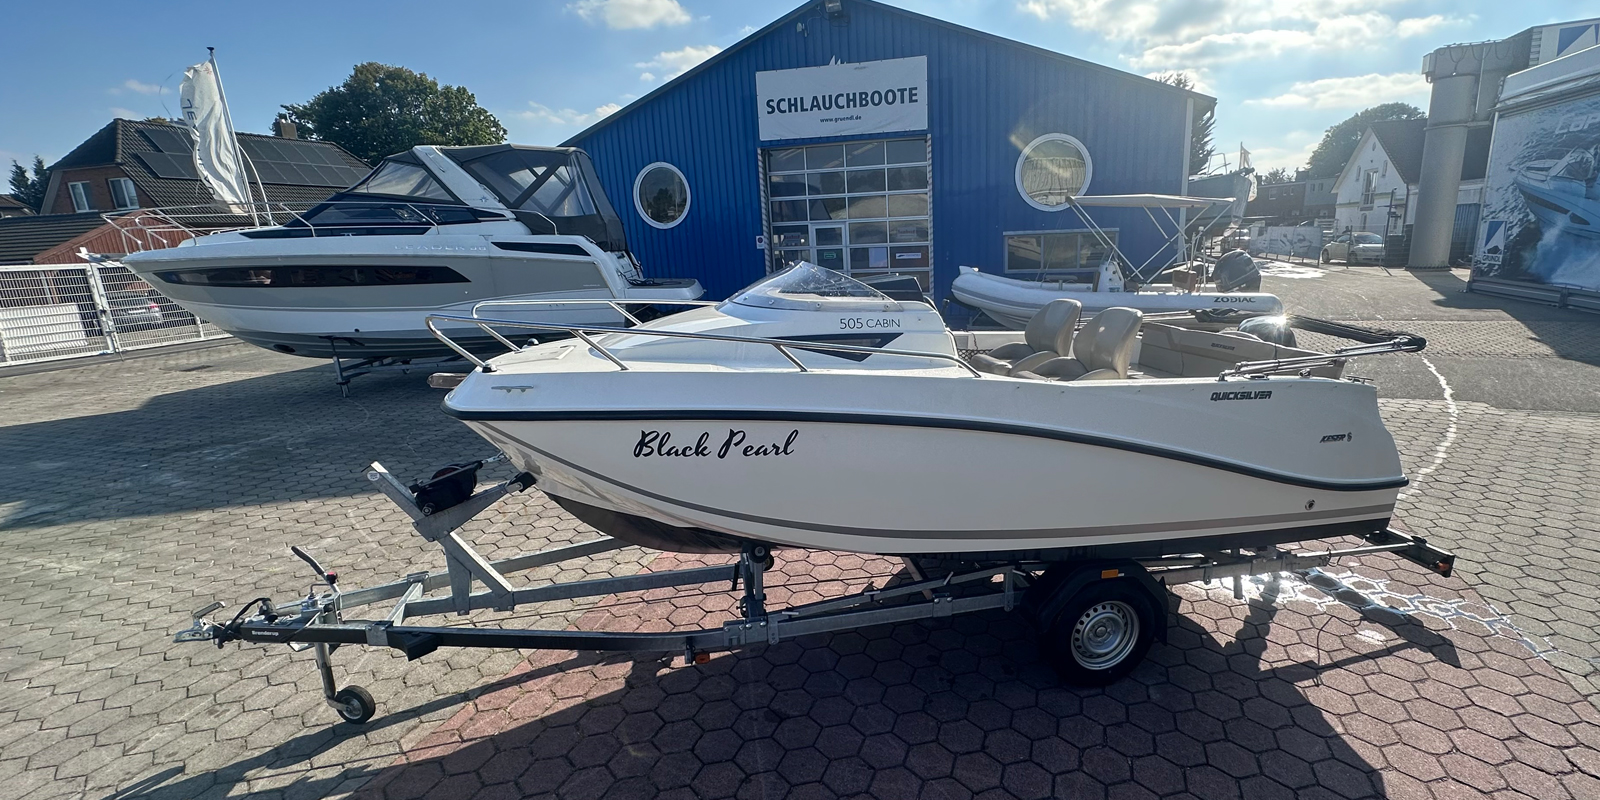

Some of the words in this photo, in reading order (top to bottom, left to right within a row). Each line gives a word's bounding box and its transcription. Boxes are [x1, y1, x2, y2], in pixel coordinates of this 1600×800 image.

[766, 86, 919, 115] SCHLAUCHBOOTE
[819, 114, 862, 124] www.gruendl.de
[839, 317, 864, 330] 505
[866, 318, 901, 329] CABIN
[1210, 390, 1273, 401] QUICKSILVER
[633, 429, 712, 458] Black
[716, 428, 799, 459] Pearl
